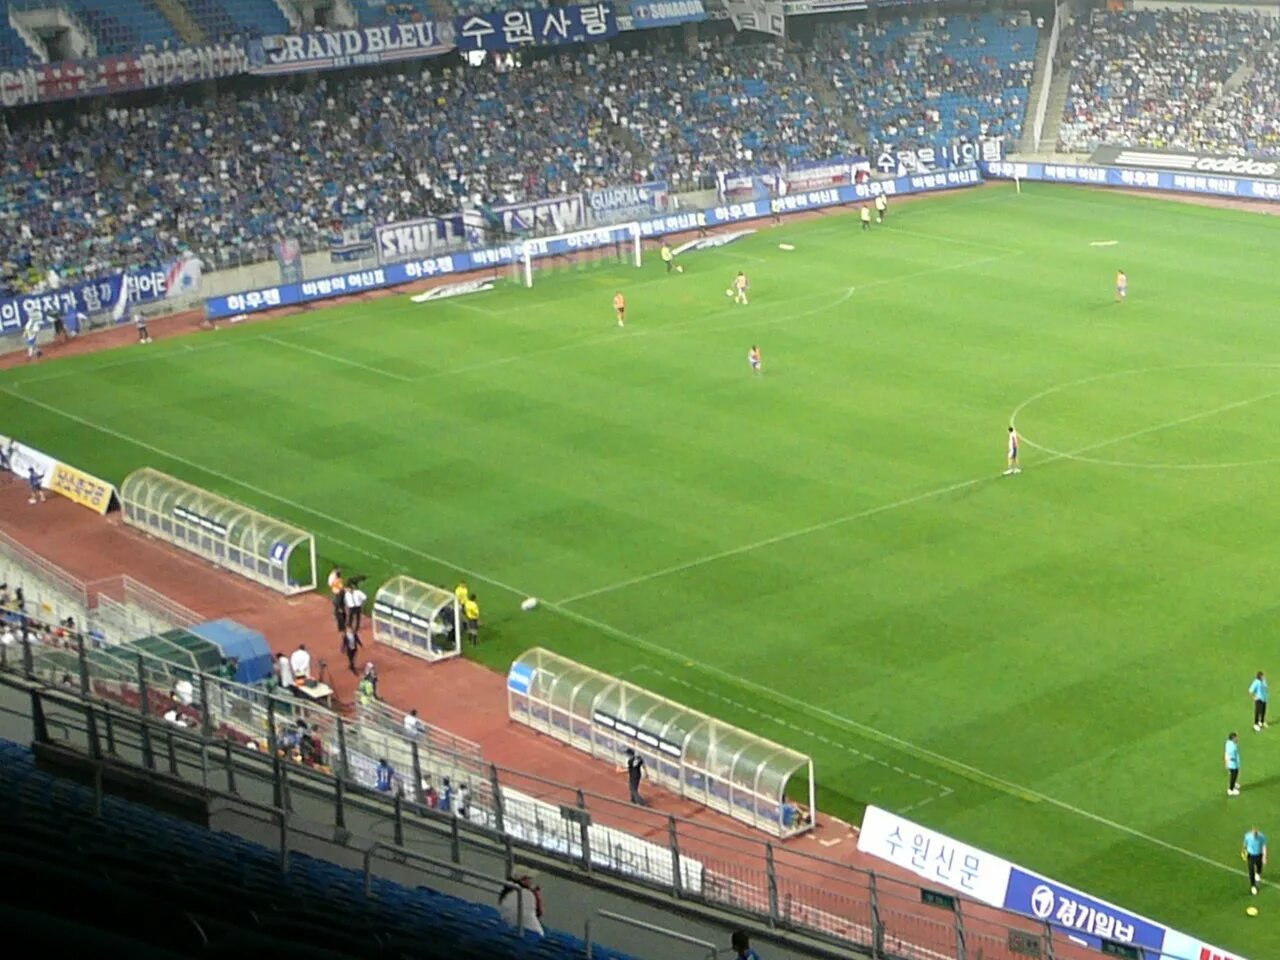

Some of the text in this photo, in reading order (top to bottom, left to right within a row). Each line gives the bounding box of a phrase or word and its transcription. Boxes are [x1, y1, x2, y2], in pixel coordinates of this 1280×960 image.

[364, 21, 433, 52] BLEU
[461, 4, 610, 48] 수원사랑
[1196, 156, 1280, 176] adidas
[380, 220, 463, 258] SKULL
[629, 220, 665, 237] 람의
[0, 300, 21, 330] 의
[886, 825, 981, 891] 수원신문
